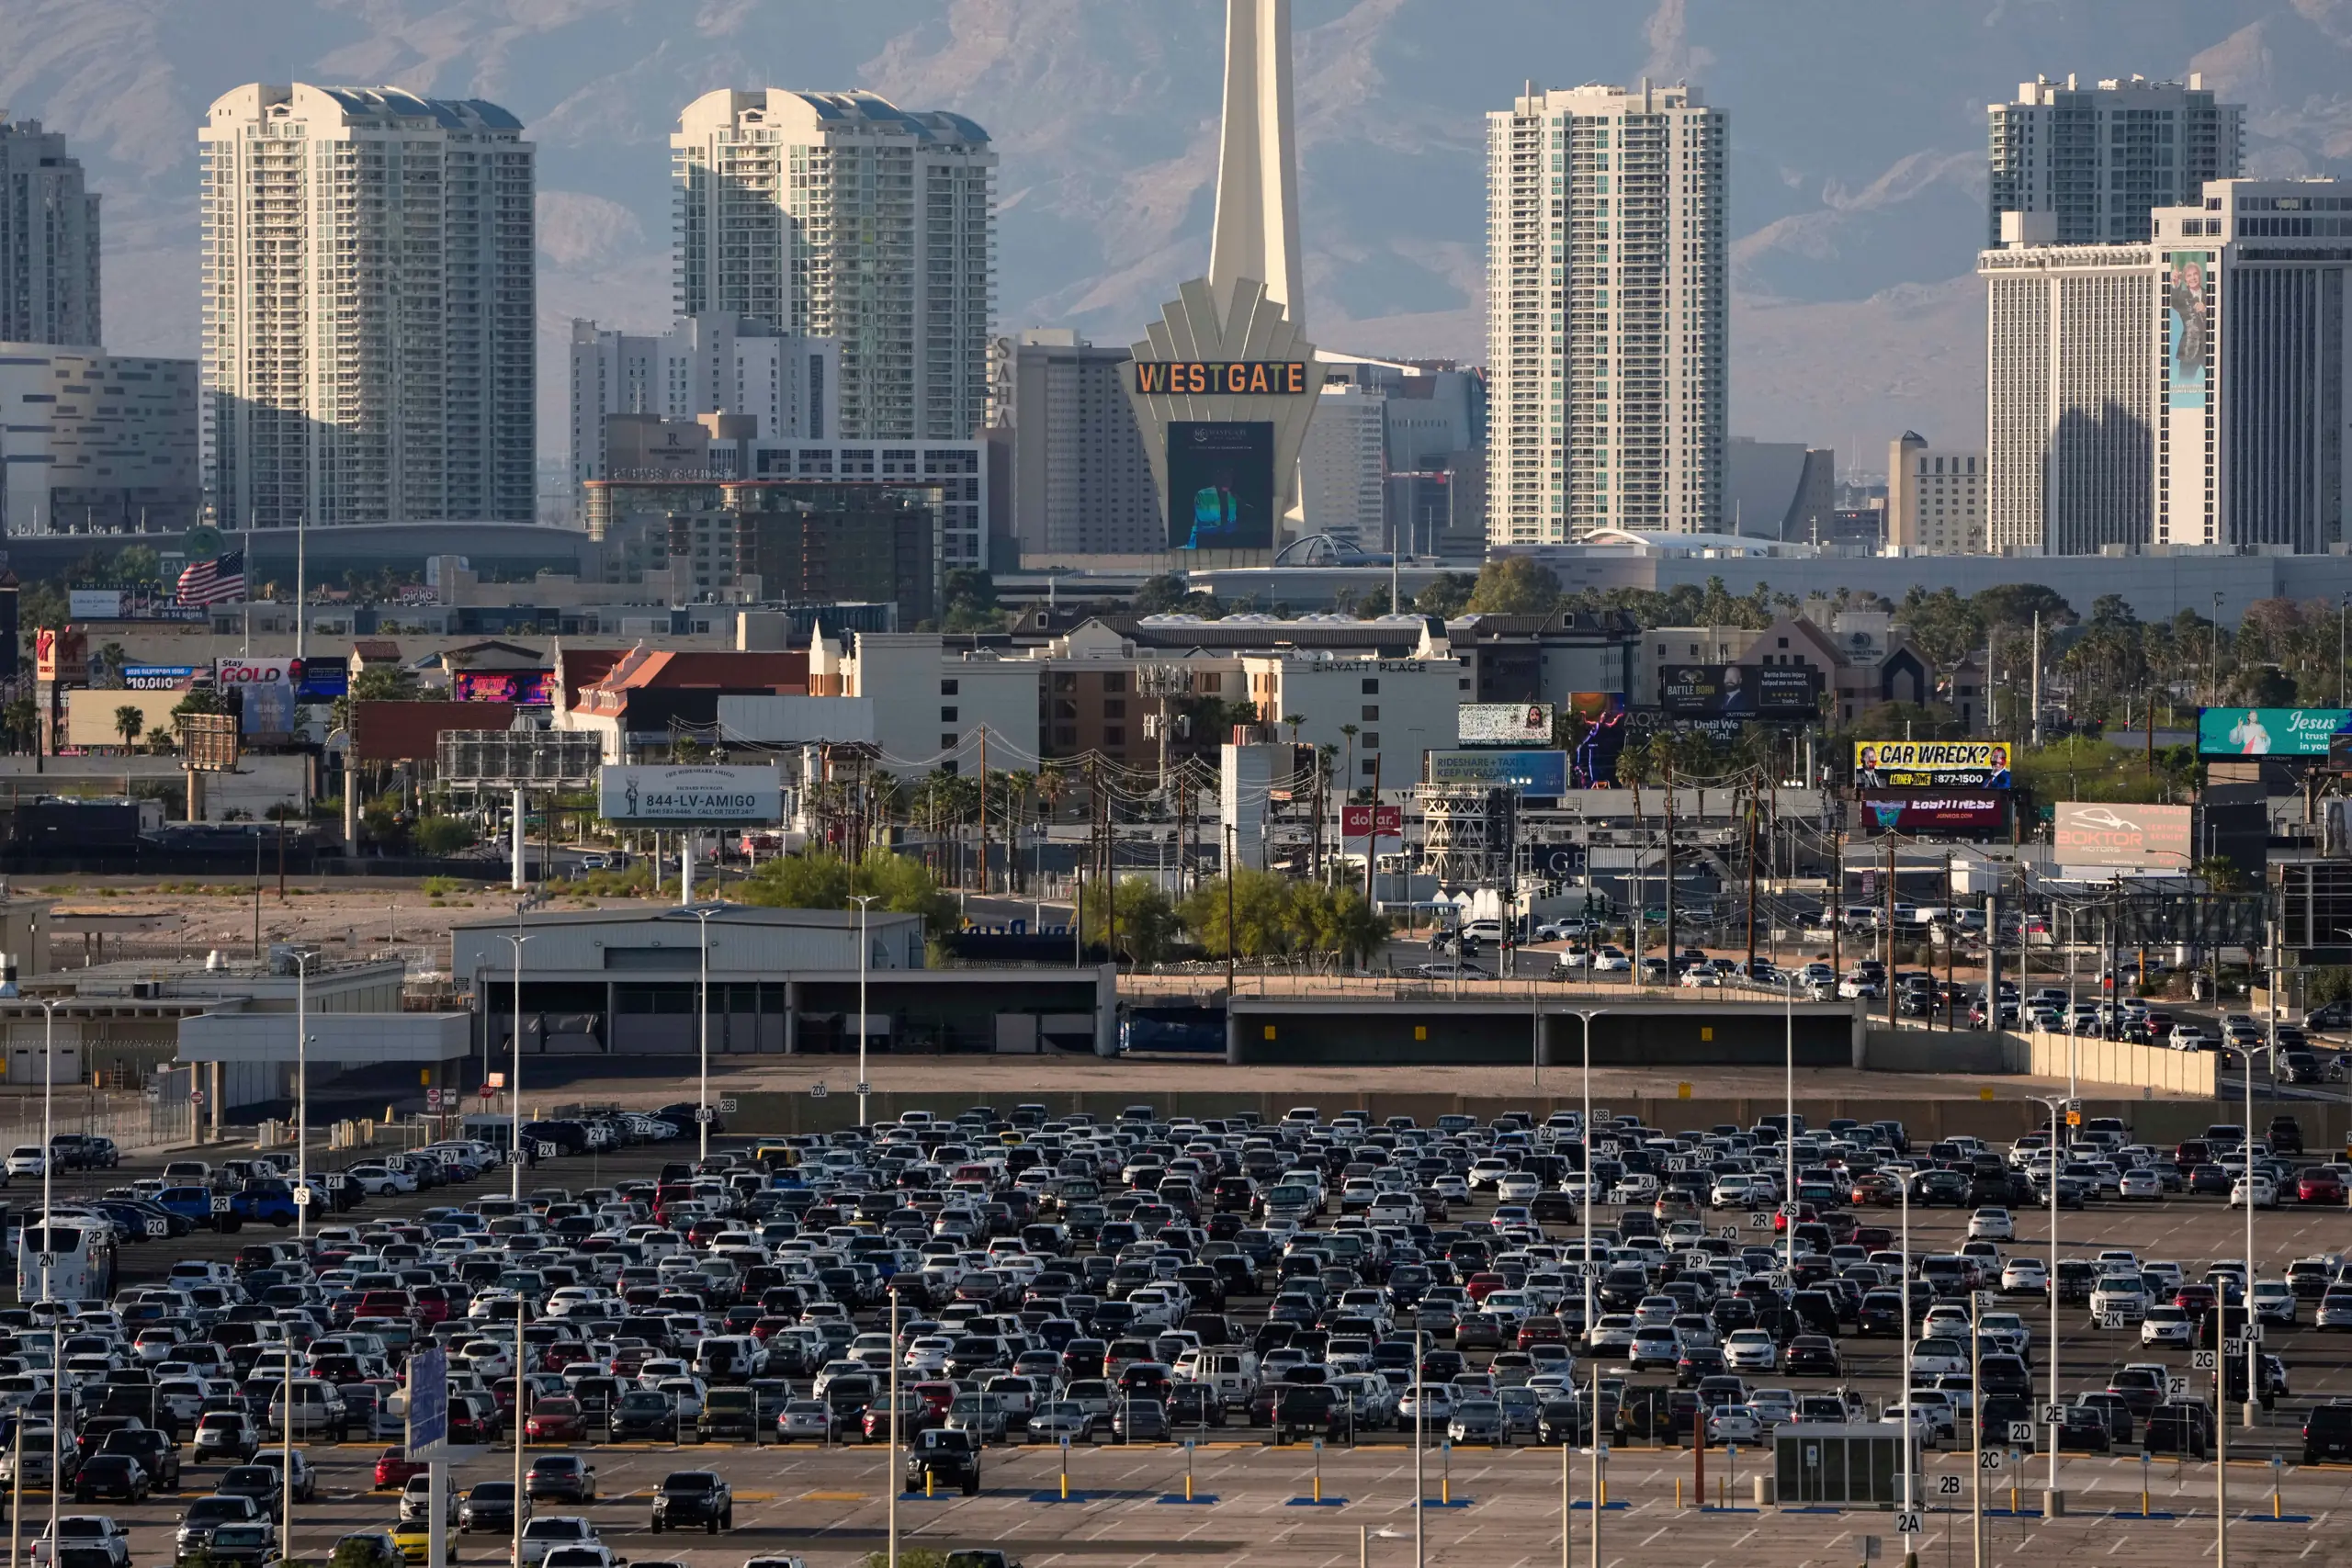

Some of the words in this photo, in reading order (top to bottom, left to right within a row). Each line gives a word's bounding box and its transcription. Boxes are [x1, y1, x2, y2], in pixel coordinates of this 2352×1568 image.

[1138, 364, 1303, 392] WESTGATE
[221, 660, 243, 668] Stay
[1325, 662, 1371, 672] HYATT
[1379, 662, 1427, 672] PLACE
[220, 667, 280, 683] GOLD
[126, 676, 174, 690] $10,000
[1667, 685, 1694, 695] BATTLE
[1695, 684, 1715, 694] BORN
[1694, 719, 1719, 729] Until
[1721, 720, 1739, 729] We
[2287, 710, 2336, 732] Jesus
[1880, 745, 1915, 764] CAR
[1918, 745, 1990, 764] WRECK?
[1437, 758, 1489, 767] RIDESHARE
[714, 769, 735, 779] AMIGO
[1437, 768, 1462, 777] KEEP
[1463, 768, 1494, 777] VEGAS
[1938, 774, 1983, 784] 877-1500
[646, 795, 756, 807] 844-LV-AMIGO
[1350, 813, 1394, 826] dolar.
[2057, 831, 2143, 846] BOKTOR
[812, 1085, 826, 1096] 2DD
[856, 1084, 869, 1094] 2EE
[721, 1100, 735, 1111] 2BB
[696, 1111, 711, 1121] 2AA
[1594, 1111, 1608, 1121] 2BB
[638, 1122, 649, 1132] 2Z
[591, 1129, 604, 1140] 2Y
[1540, 1128, 1552, 1139] 2Z
[540, 1144, 554, 1156] 2X
[1603, 1142, 1615, 1153] 2X
[444, 1152, 457, 1163] 2V
[508, 1153, 524, 1163] 2W
[1698, 1149, 1713, 1159] 2W
[389, 1156, 401, 1169] 2U
[1670, 1159, 1683, 1170] 2V
[328, 1176, 341, 1187] 2T
[1642, 1177, 1654, 1189] 2U
[296, 1190, 307, 1202] 2S
[1611, 1191, 1623, 1202] 2T
[214, 1198, 227, 1211] 2R
[1784, 1203, 1796, 1215] 2S
[1753, 1214, 1766, 1226] 2R
[149, 1221, 165, 1235] 2Q
[1722, 1227, 1736, 1240] 2Q
[88, 1231, 102, 1244] 2P
[40, 1253, 54, 1267] 2N
[1690, 1256, 1702, 1268] 2P
[1582, 1264, 1596, 1276] 2N
[1771, 1275, 1787, 1288] 2M
[2104, 1314, 2120, 1326] 2K
[2245, 1325, 2259, 1340] 2J
[2224, 1340, 2239, 1354] 2H
[2196, 1352, 2213, 1368] 2G
[2170, 1378, 2186, 1393] 2F
[2045, 1406, 2063, 1421] 2E
[2012, 1424, 2030, 1439] 2D
[1981, 1451, 1999, 1469] 2C
[1940, 1477, 1959, 1494] 2B
[1898, 1515, 1919, 1532] 2A
